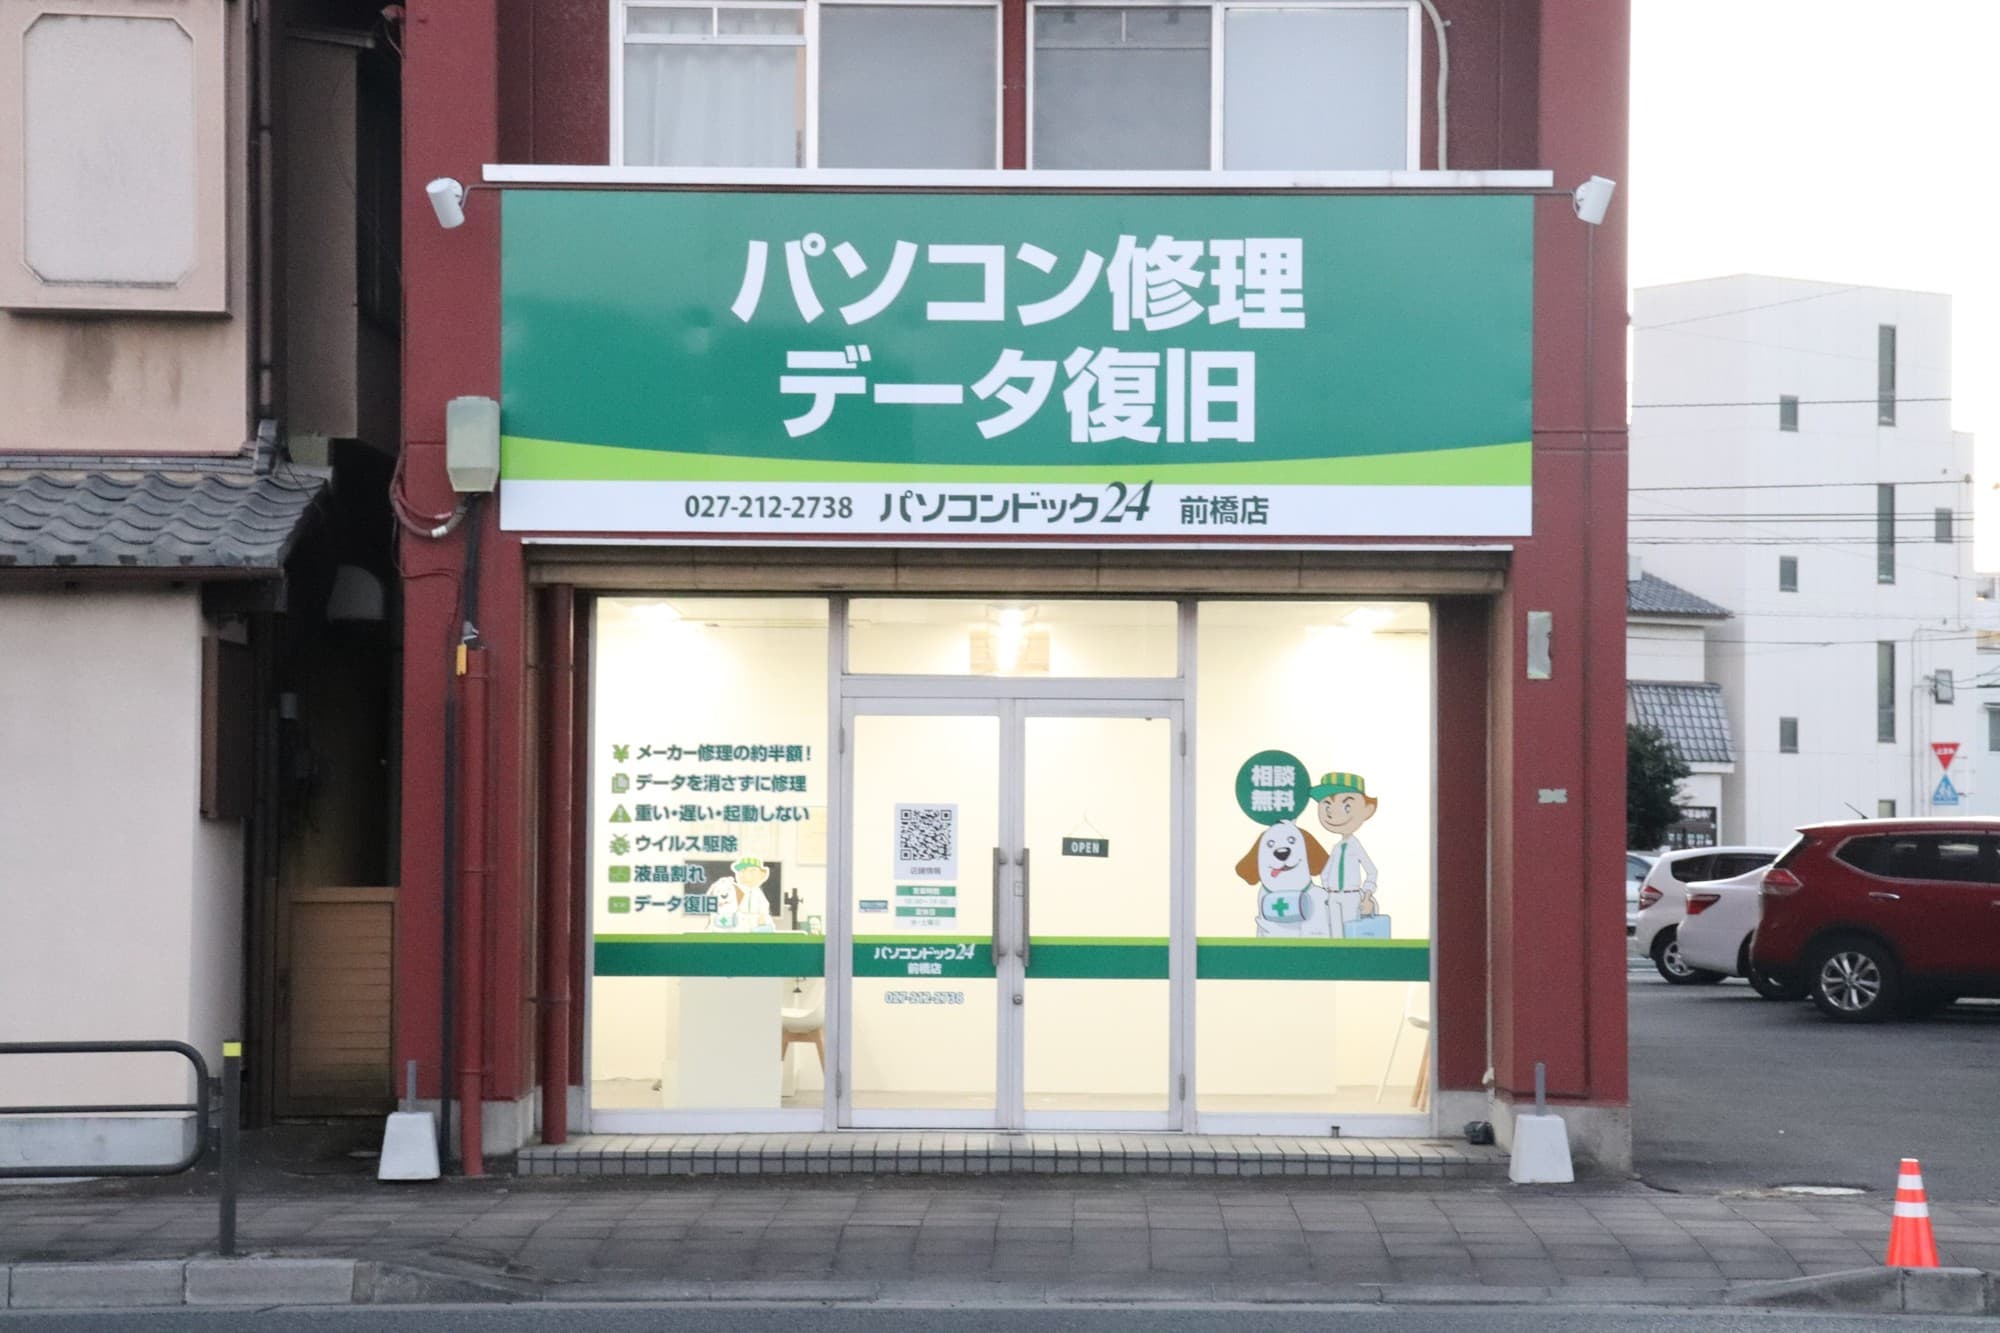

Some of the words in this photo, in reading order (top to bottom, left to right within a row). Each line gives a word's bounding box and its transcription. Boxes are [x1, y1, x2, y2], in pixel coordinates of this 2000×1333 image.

[731, 232, 1306, 331] パソコン修理
[780, 344, 1256, 443] データ復旧
[684, 494, 853, 519] 027-212-2738
[879, 479, 1154, 523] パソコンドック24
[1179, 495, 1270, 525] 前橋店
[636, 774, 807, 792] データを消さずに修理
[1251, 764, 1296, 787] 相談
[1251, 789, 1296, 812] 無料
[635, 804, 809, 822] 重い・遅い・起動しない
[635, 835, 738, 852] ウイルス駆除
[1071, 841, 1100, 854] OPEN
[634, 865, 705, 883] 液晶割れ
[635, 895, 718, 914] データ復旧
[873, 943, 976, 960] パソコンドック24
